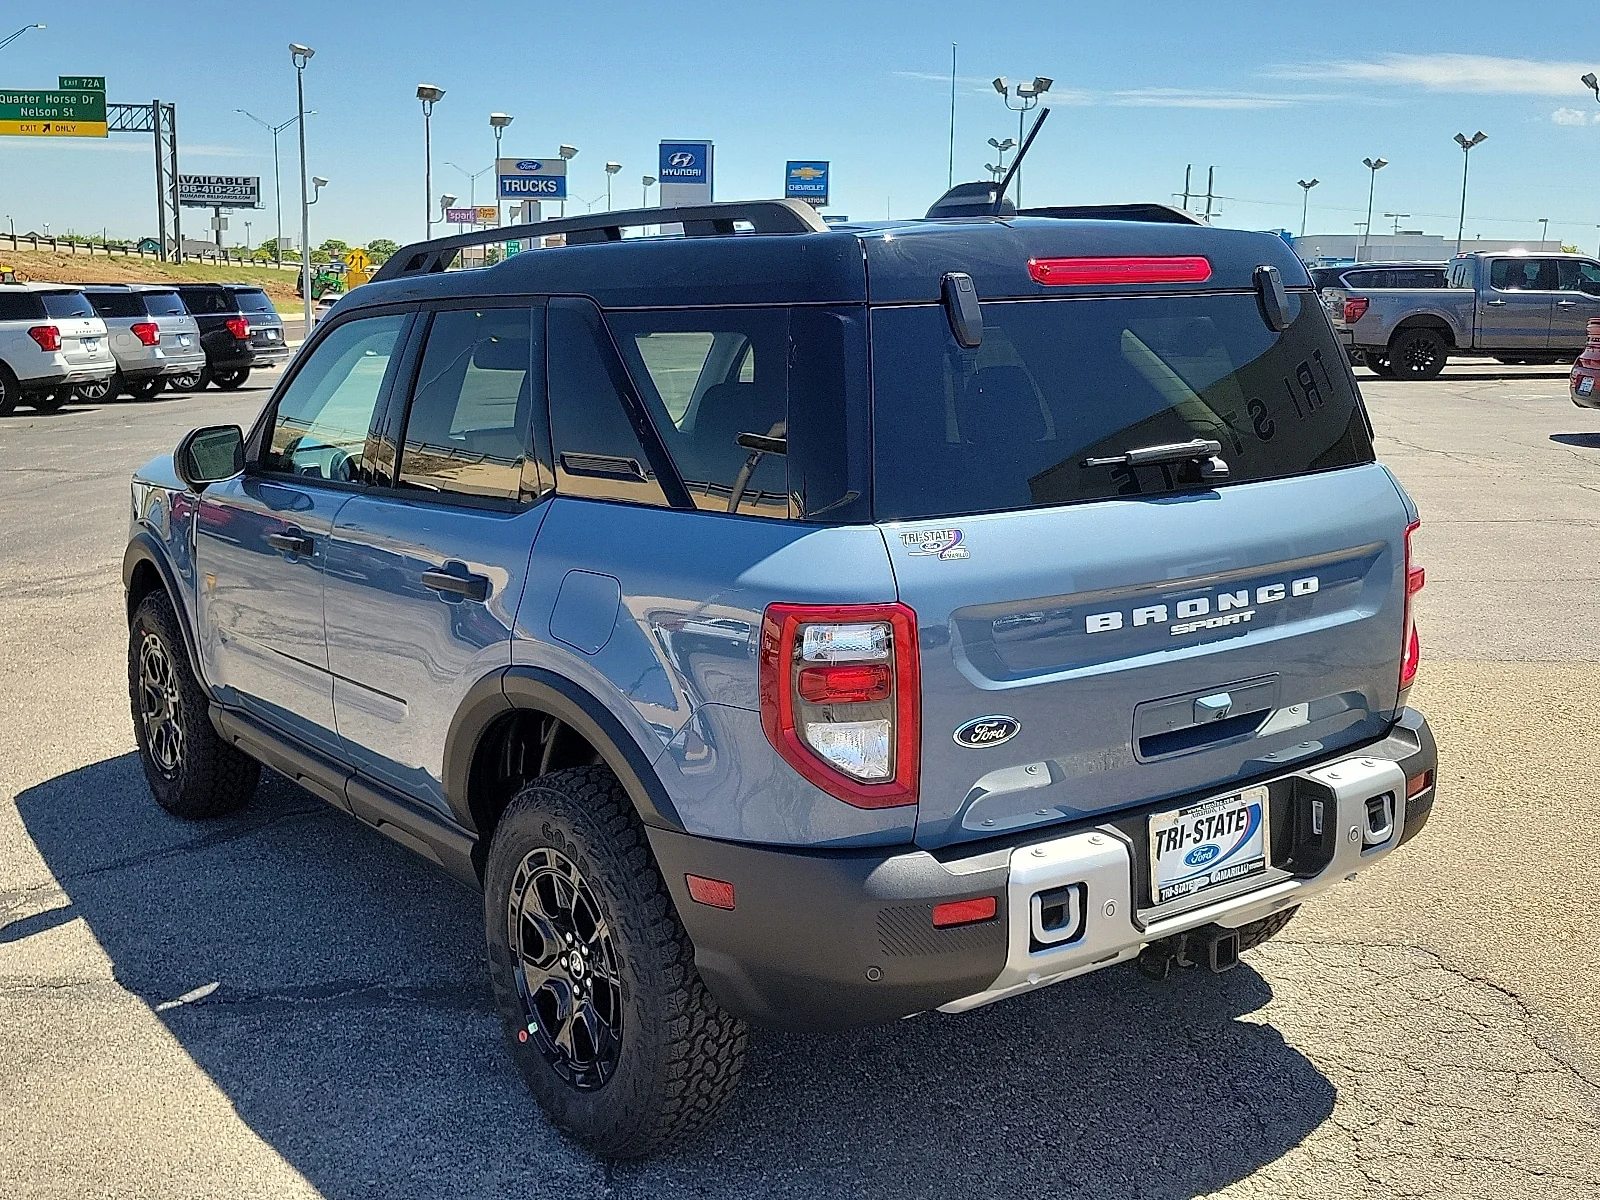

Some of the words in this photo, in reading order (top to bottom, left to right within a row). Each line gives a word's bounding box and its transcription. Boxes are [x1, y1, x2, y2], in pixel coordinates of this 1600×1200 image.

[82, 78, 100, 88] 72A
[0, 94, 40, 104] Quarter
[45, 94, 77, 104] Horse
[82, 95, 95, 104] Dr
[20, 107, 58, 117] Nelson
[63, 107, 74, 117] St
[661, 168, 702, 177] HYUNDAI
[502, 179, 557, 193] TRUCKS
[900, 530, 954, 547] TRI-STATE
[1085, 576, 1320, 634] BRONCO
[1169, 610, 1256, 636] SPORT
[1155, 807, 1247, 861] TRI-STATE
